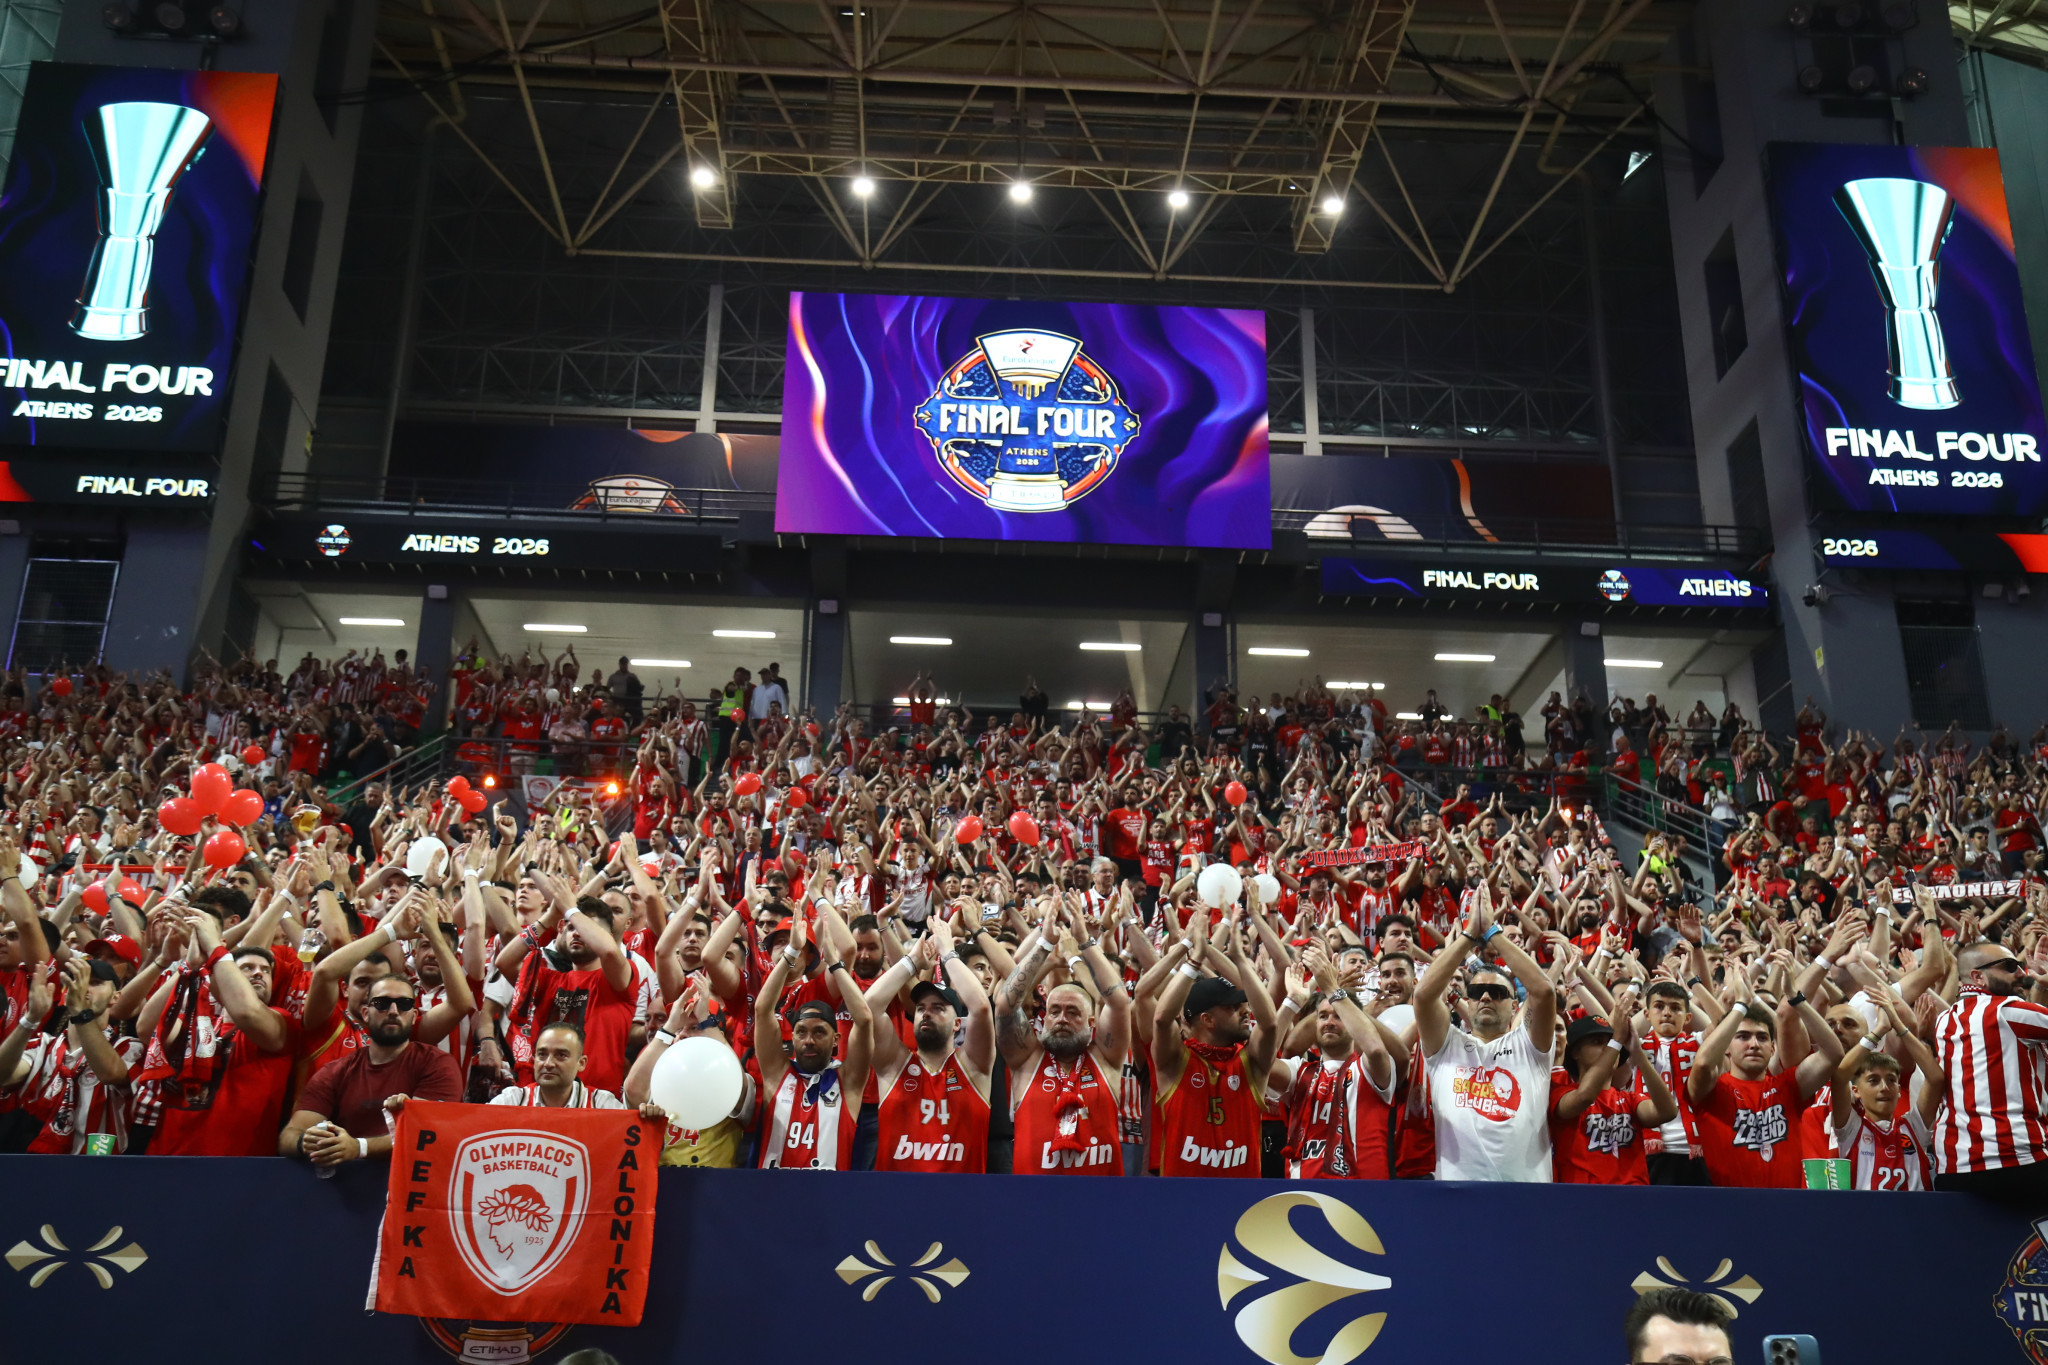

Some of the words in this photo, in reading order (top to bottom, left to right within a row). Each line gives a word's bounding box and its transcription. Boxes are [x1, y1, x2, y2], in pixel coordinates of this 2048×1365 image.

[102, 363, 214, 397] FOUR
[12, 400, 94, 420] ATHENS
[104, 404, 163, 423] 2026
[939, 403, 1029, 435] FINAL
[1037, 406, 1116, 438] FOUR
[1006, 447, 1049, 456] ATHENS
[1825, 427, 1934, 461] FINAL
[1936, 431, 2041, 462] FOUR
[76, 475, 142, 497] FINAL
[145, 478, 209, 497] FOUR
[1869, 468, 1940, 487] ATHENS
[1951, 471, 2004, 489] 2026
[401, 534, 481, 553] ATHENS
[492, 537, 550, 556] 2026
[1823, 538, 1879, 557] 2026
[1423, 570, 1482, 590] FINAL
[1483, 572, 1540, 591] FOUR
[1679, 578, 1753, 597] ATHENS
[1147, 850, 1165, 859] ARE
[1147, 858, 1172, 867] BACK
[920, 1098, 951, 1126] 94
[1312, 1099, 1332, 1125] 14
[1455, 1093, 1494, 1113] CLUB
[667, 1125, 700, 1147] 94
[787, 1121, 815, 1150] 94
[469, 1142, 576, 1167] OLYMPIACOS
[893, 1134, 965, 1162] bwin
[1041, 1136, 1114, 1169] bwin
[1180, 1135, 1248, 1169] bwin
[482, 1160, 559, 1179] BASKETBALL
[1877, 1166, 1907, 1191] 22
[398, 1129, 437, 1279] PEFKA
[600, 1125, 642, 1315] SALONIKA
[524, 1236, 544, 1246] 1925
[469, 1345, 522, 1354] ETIHAD
